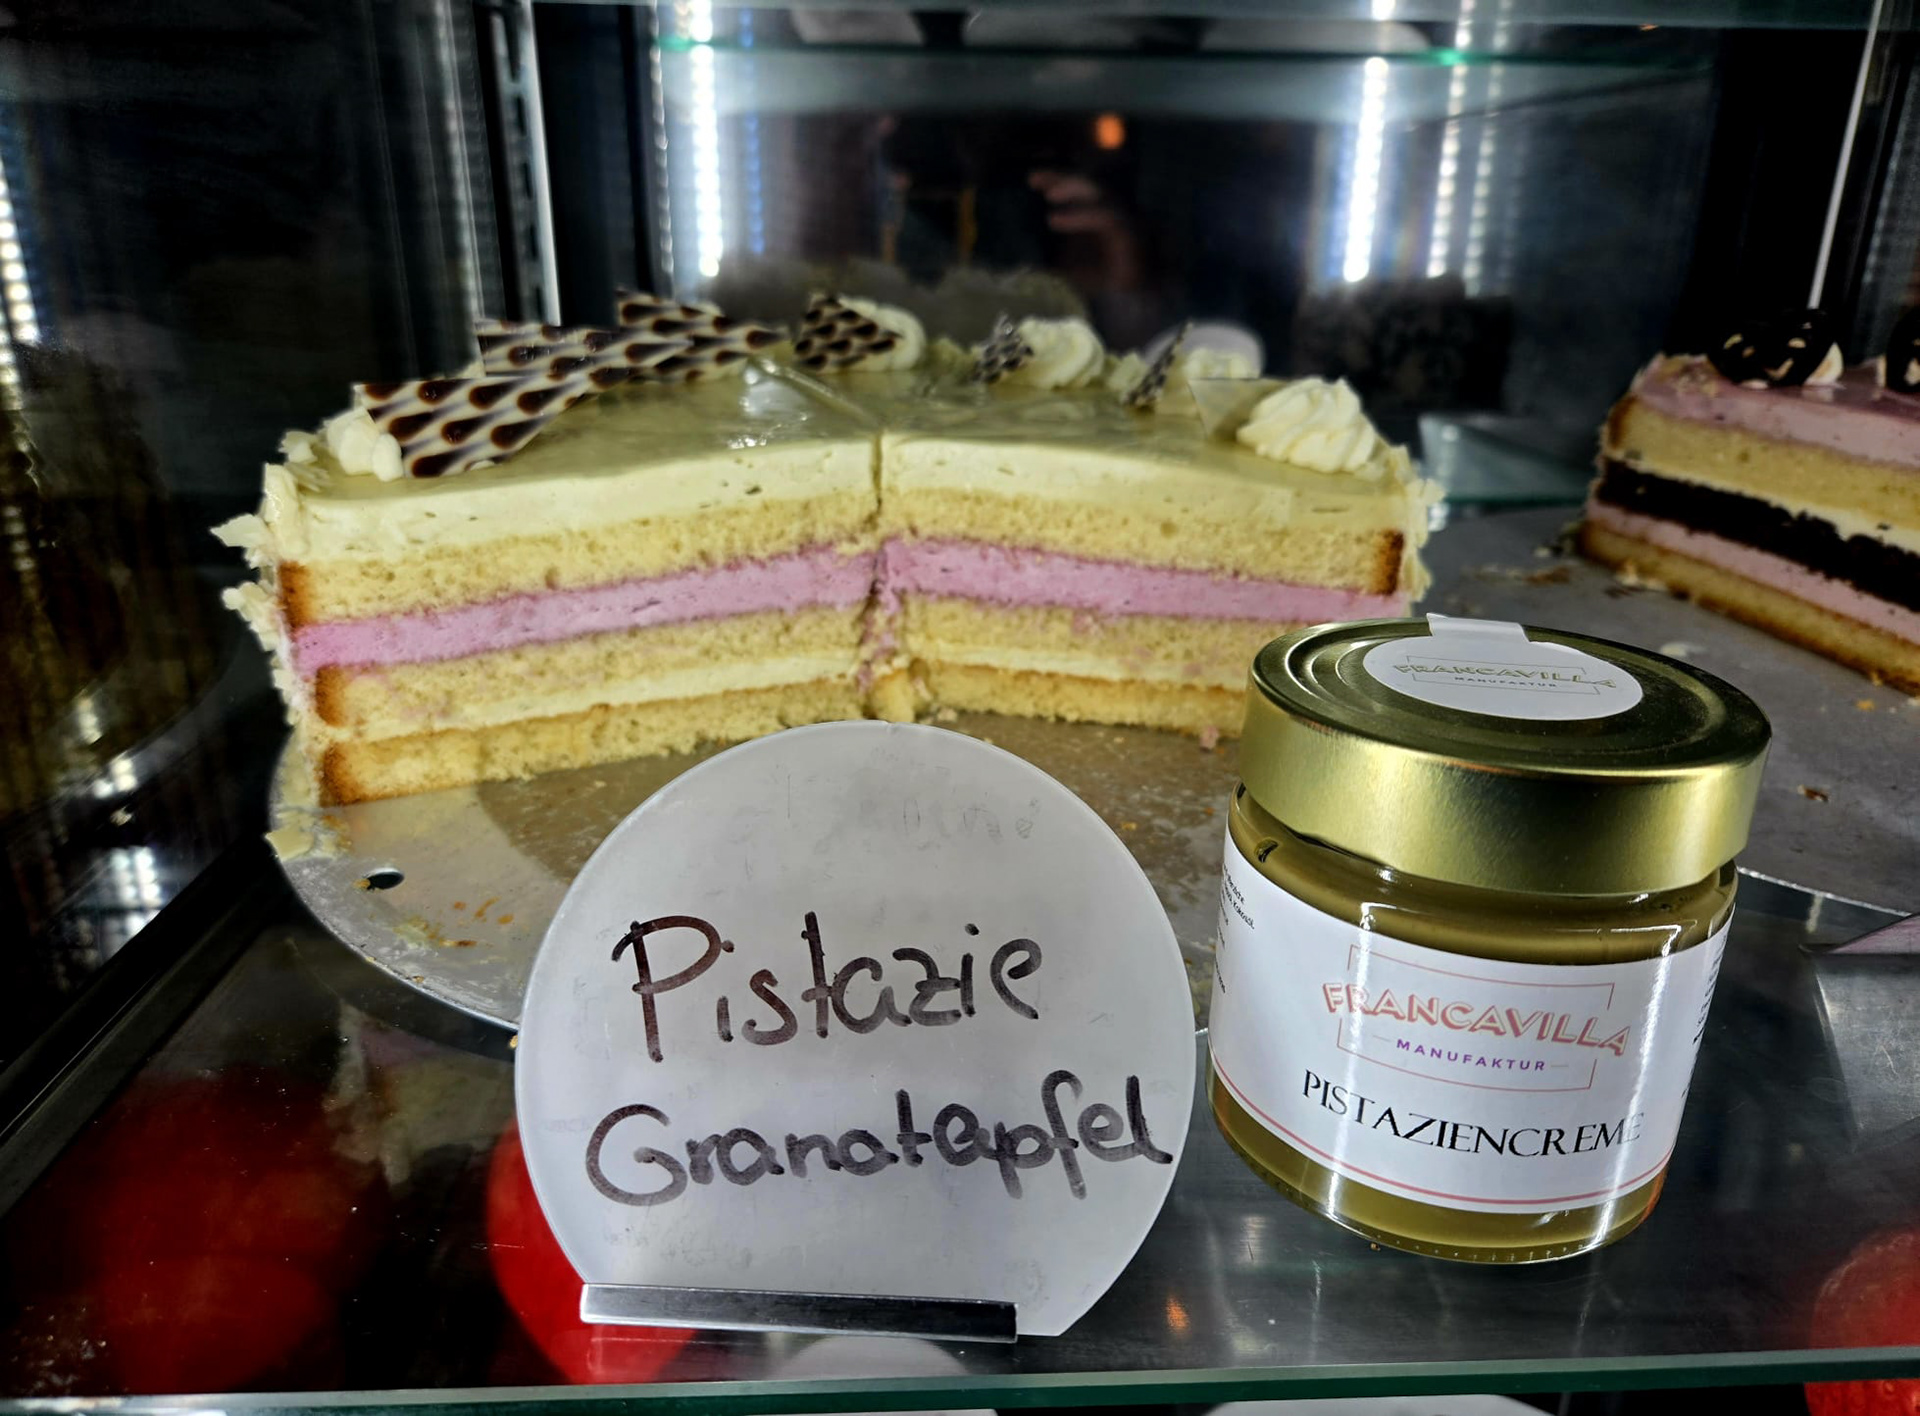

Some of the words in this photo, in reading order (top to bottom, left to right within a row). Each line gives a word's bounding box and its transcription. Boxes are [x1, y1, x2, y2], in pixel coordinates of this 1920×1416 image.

[1394, 663, 1617, 689] FRANCAVILLA
[1453, 676, 1558, 688] MANUFAKTUR
[611, 911, 1042, 1062] Pistazie
[1322, 982, 1632, 1057] FRANCAVILLA
[1396, 1038, 1546, 1072] MANUFAKTUR
[1302, 1068, 1645, 1158] PISTAZIENCREME
